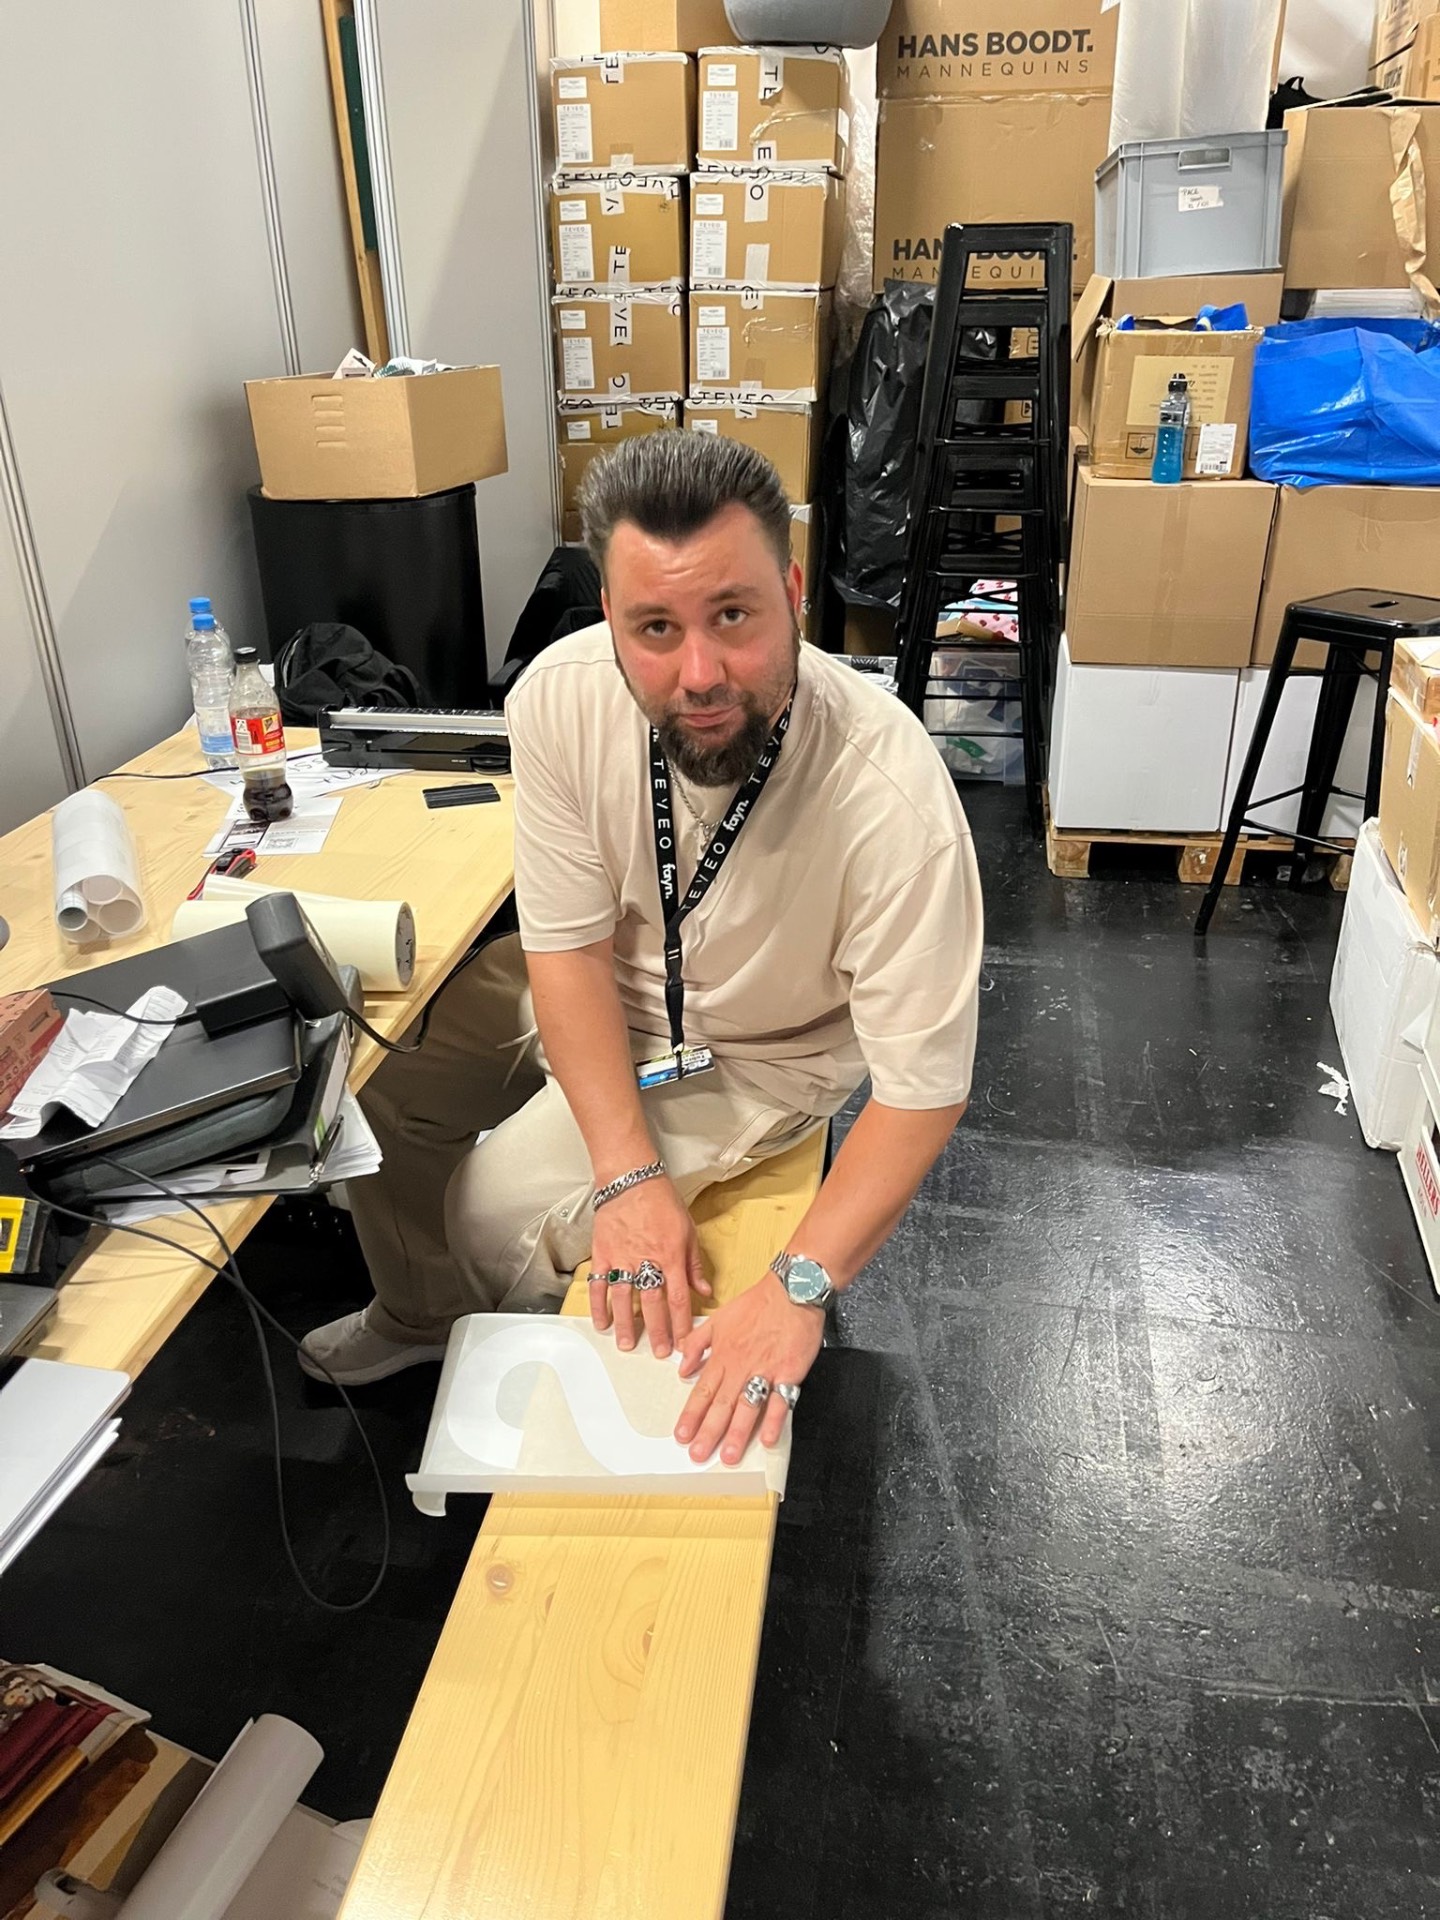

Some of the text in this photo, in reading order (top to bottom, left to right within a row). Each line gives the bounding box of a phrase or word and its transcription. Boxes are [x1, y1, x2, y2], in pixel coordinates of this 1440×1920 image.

[898, 29, 1094, 59] HANS BOODT.
[897, 60, 1089, 79] MANNEQUINS
[653, 758, 672, 849] TEVEO
[722, 799, 749, 832] fayn.
[660, 863, 676, 899] fayn.
[680, 842, 726, 911] TEVEO
